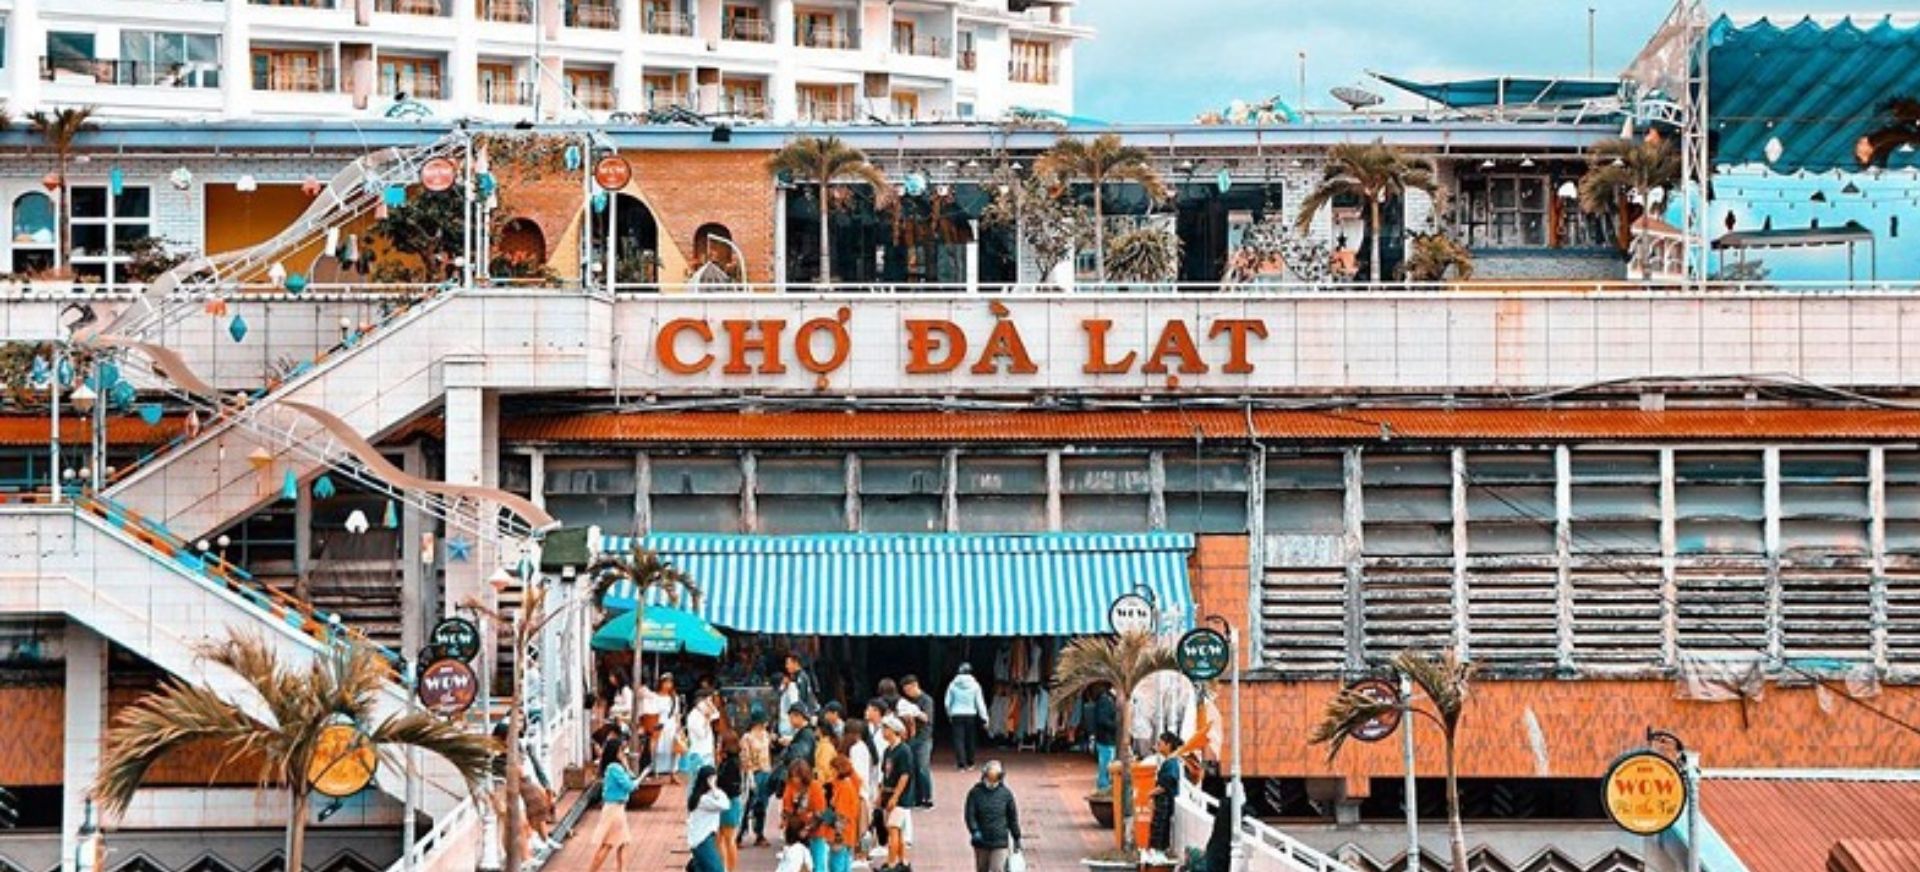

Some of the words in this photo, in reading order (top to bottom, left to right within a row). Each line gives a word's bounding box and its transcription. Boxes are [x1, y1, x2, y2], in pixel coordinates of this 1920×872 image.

[656, 307, 850, 390] CHỢ
[905, 301, 1038, 374] ĐÀ
[1081, 319, 1269, 390] LẠT
[1615, 779, 1677, 795] WOW
